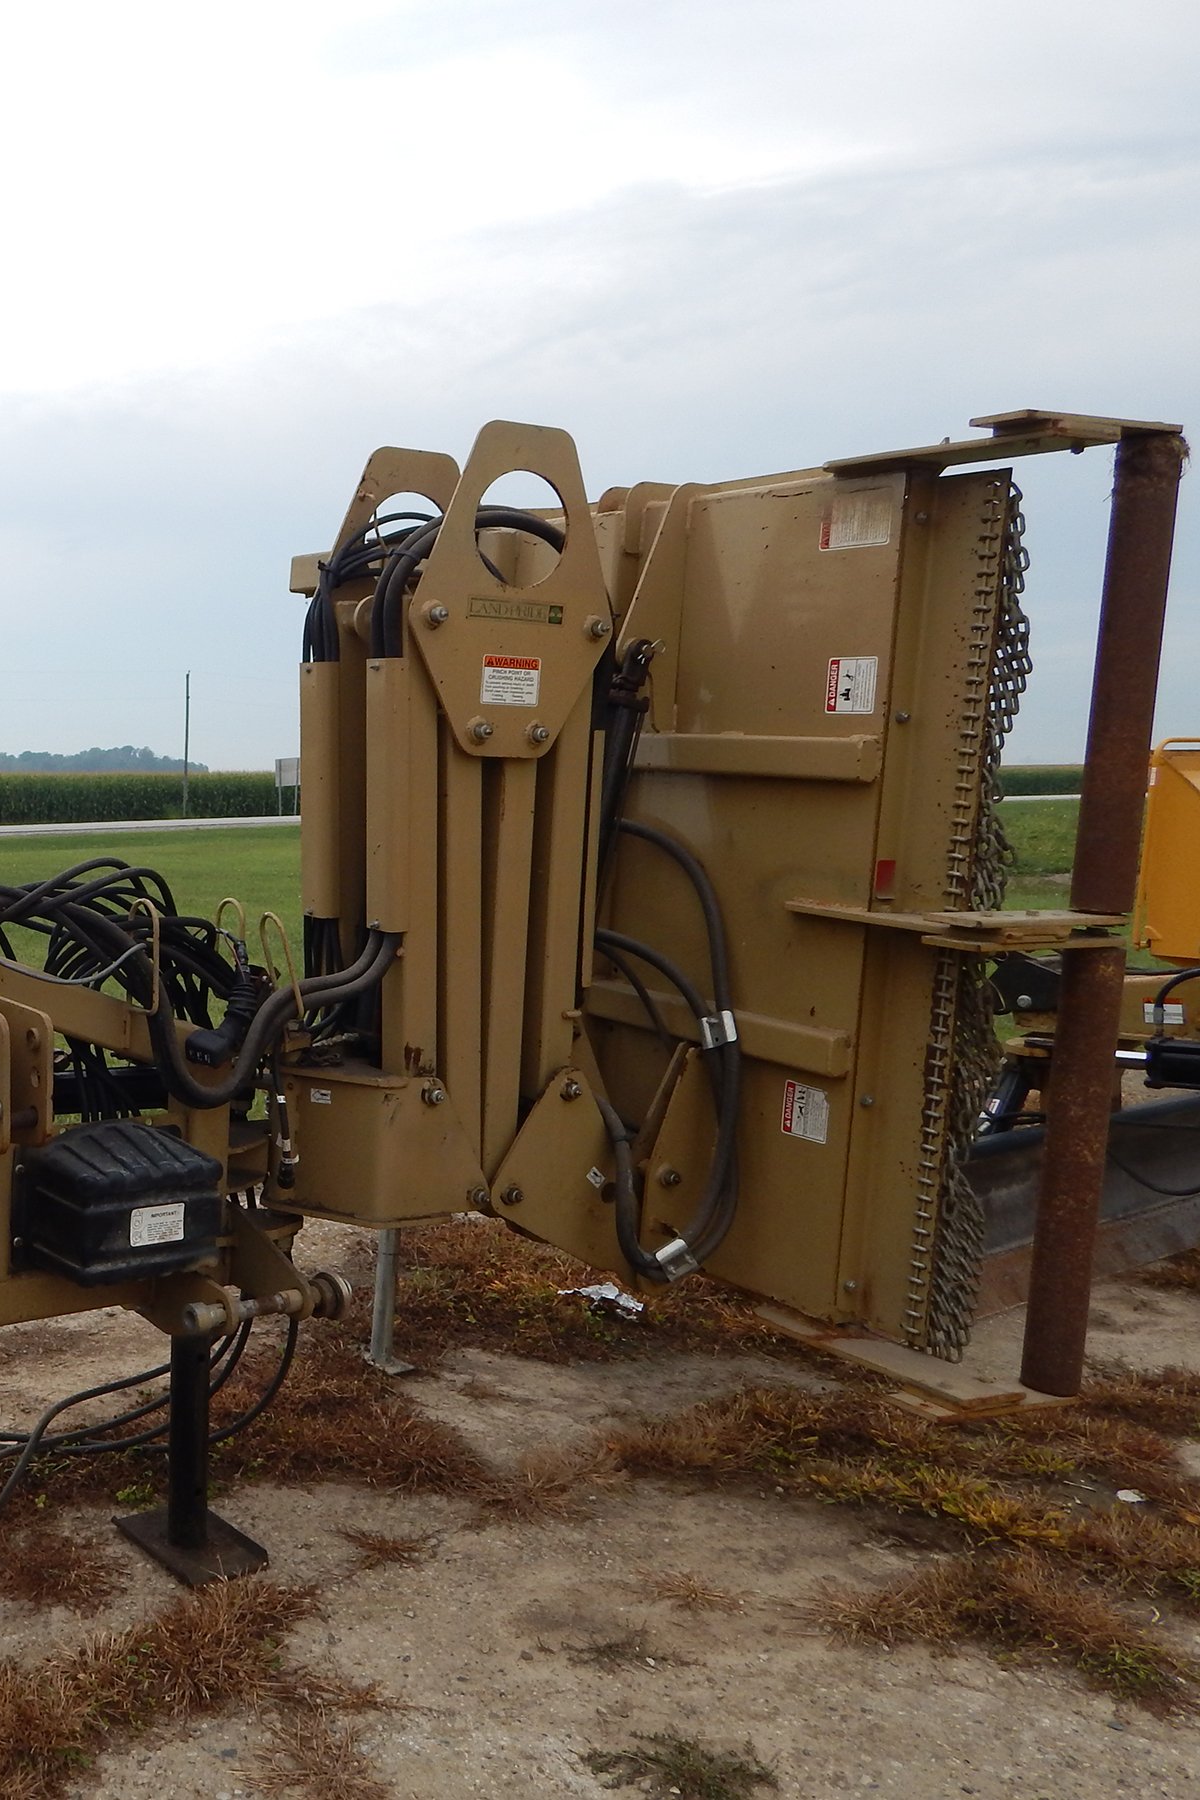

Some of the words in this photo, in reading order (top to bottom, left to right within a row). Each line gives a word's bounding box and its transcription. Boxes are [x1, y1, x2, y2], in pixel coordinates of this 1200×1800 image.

[470, 601, 508, 615] LAND
[495, 658, 538, 668] WARNING
[829, 664, 838, 697] DANGER
[785, 1087, 794, 1119] DANGER
